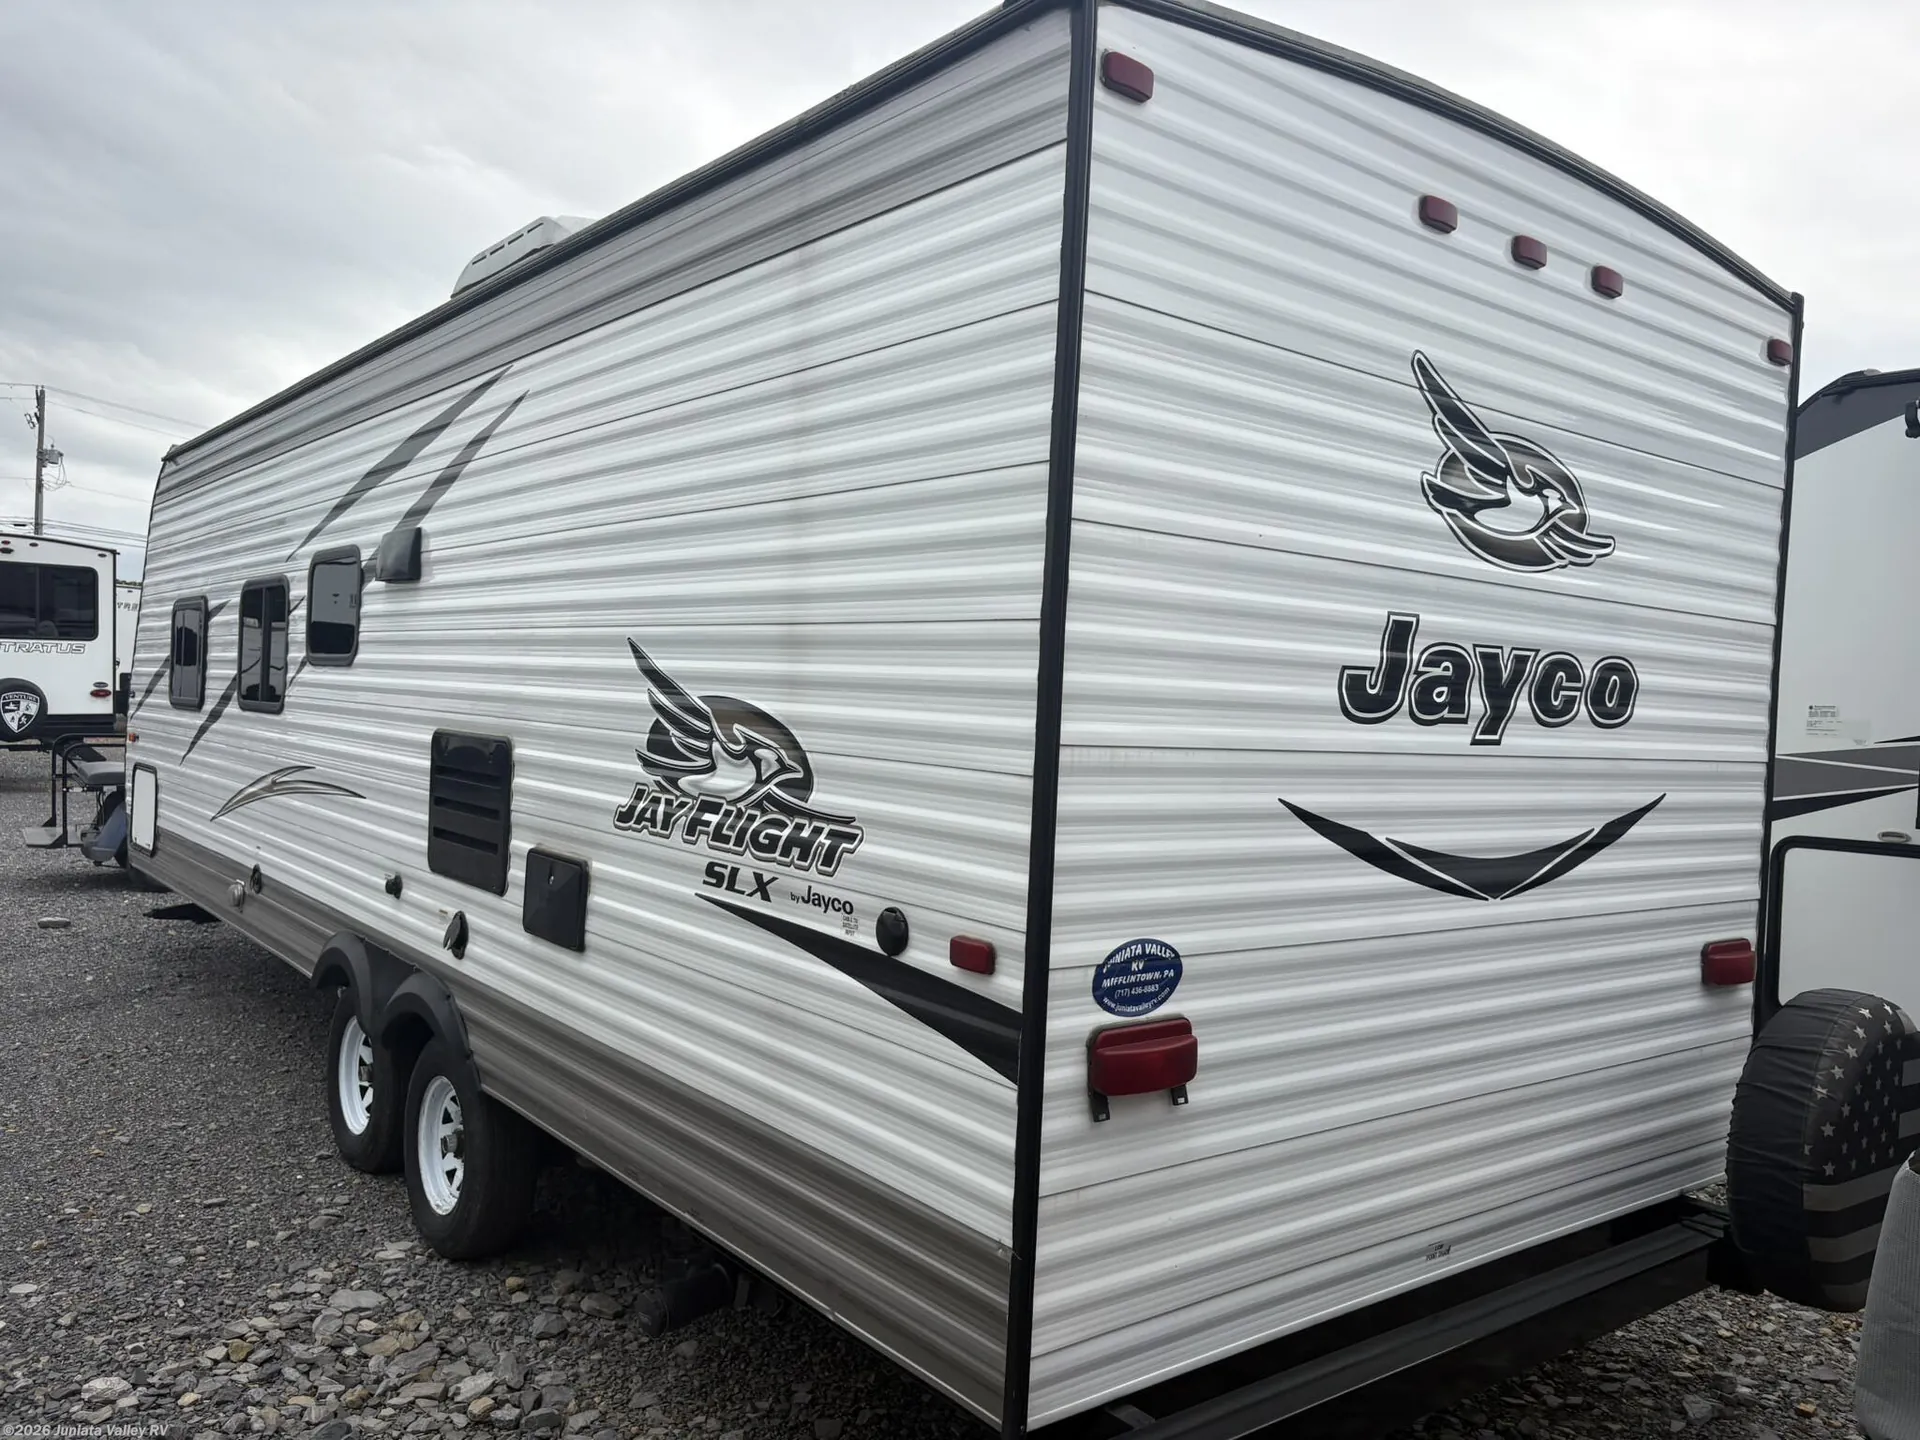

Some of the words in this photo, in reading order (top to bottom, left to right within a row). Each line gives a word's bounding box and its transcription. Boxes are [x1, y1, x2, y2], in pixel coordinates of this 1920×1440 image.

[0, 641, 86, 655] TRATUS
[1338, 611, 1640, 746] Jayco
[614, 783, 696, 839] JAY
[682, 793, 864, 877] FLIGHT
[702, 861, 779, 903] SLX
[790, 892, 800, 904] by
[801, 885, 854, 915] Jayco
[1103, 943, 1142, 973] JUNIATA
[1145, 943, 1175, 960] VALLEY
[1131, 960, 1145, 971] RV
[1163, 969, 1175, 978] PA
[1103, 987, 1170, 1012] www.juniatavalleyrv.com
[1114, 988, 1130, 999] (717)
